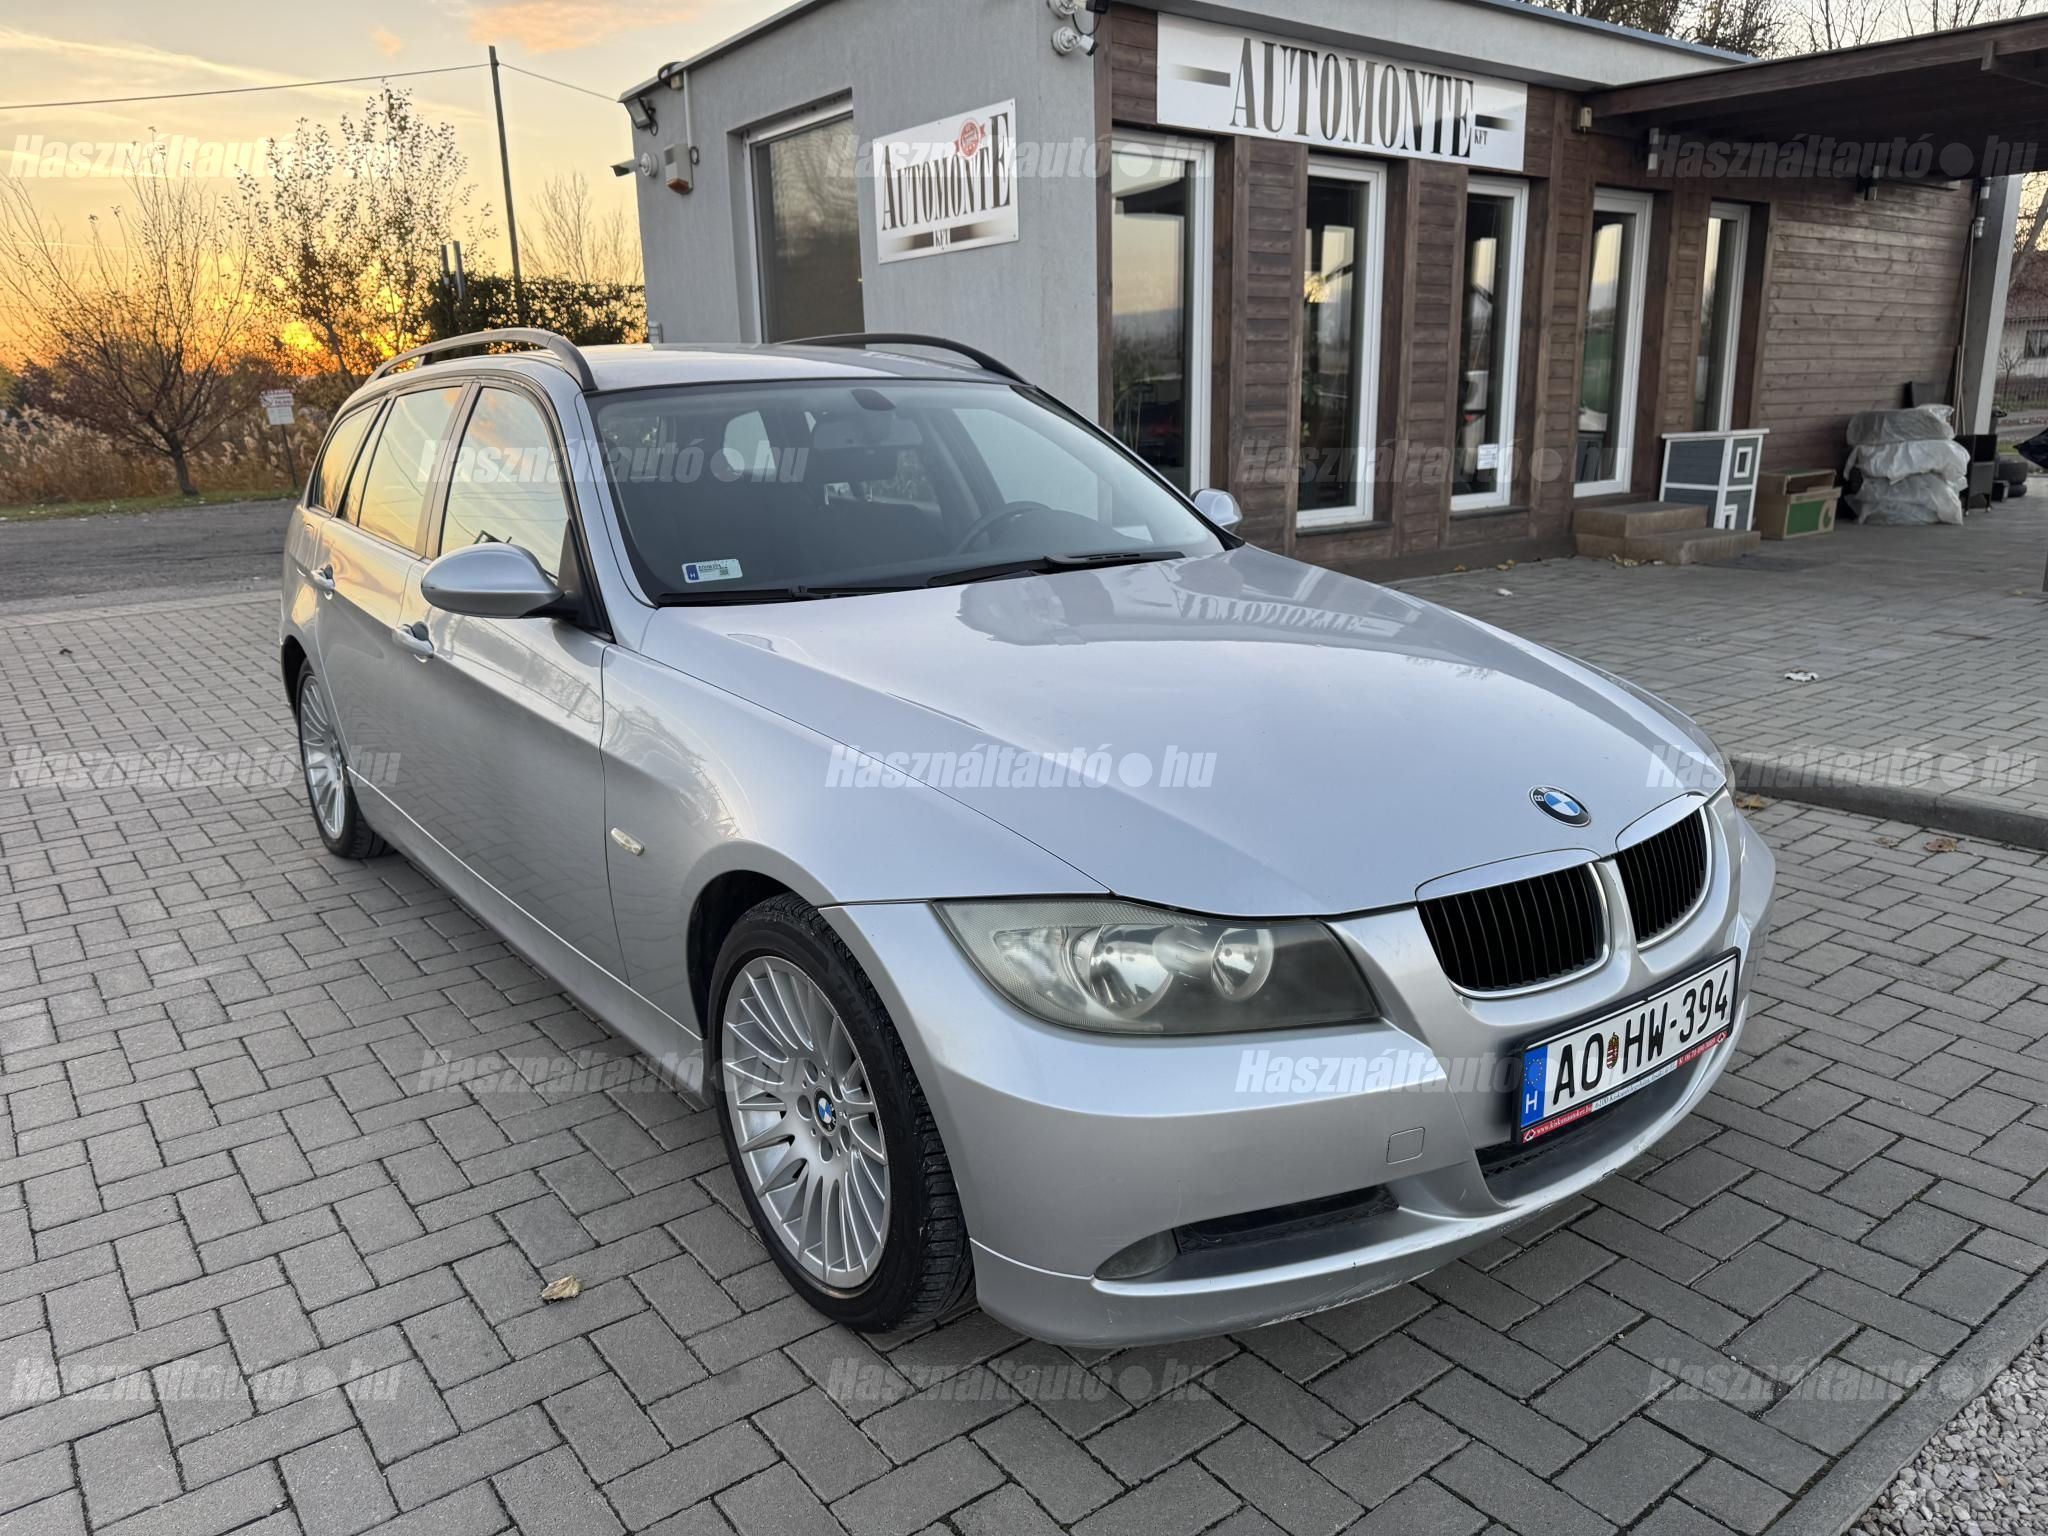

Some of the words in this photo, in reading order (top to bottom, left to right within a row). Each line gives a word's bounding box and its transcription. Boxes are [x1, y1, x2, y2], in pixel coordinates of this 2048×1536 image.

[1230, 38, 1474, 158] AUTOMONTE
[1474, 130, 1488, 145] KFT
[882, 112, 1010, 231] AUTOMONTE
[935, 228, 949, 250] KFT
[1553, 1032, 1604, 1106] AO
[1623, 969, 1729, 1074] HW-394
[1525, 1090, 1538, 1114] H
